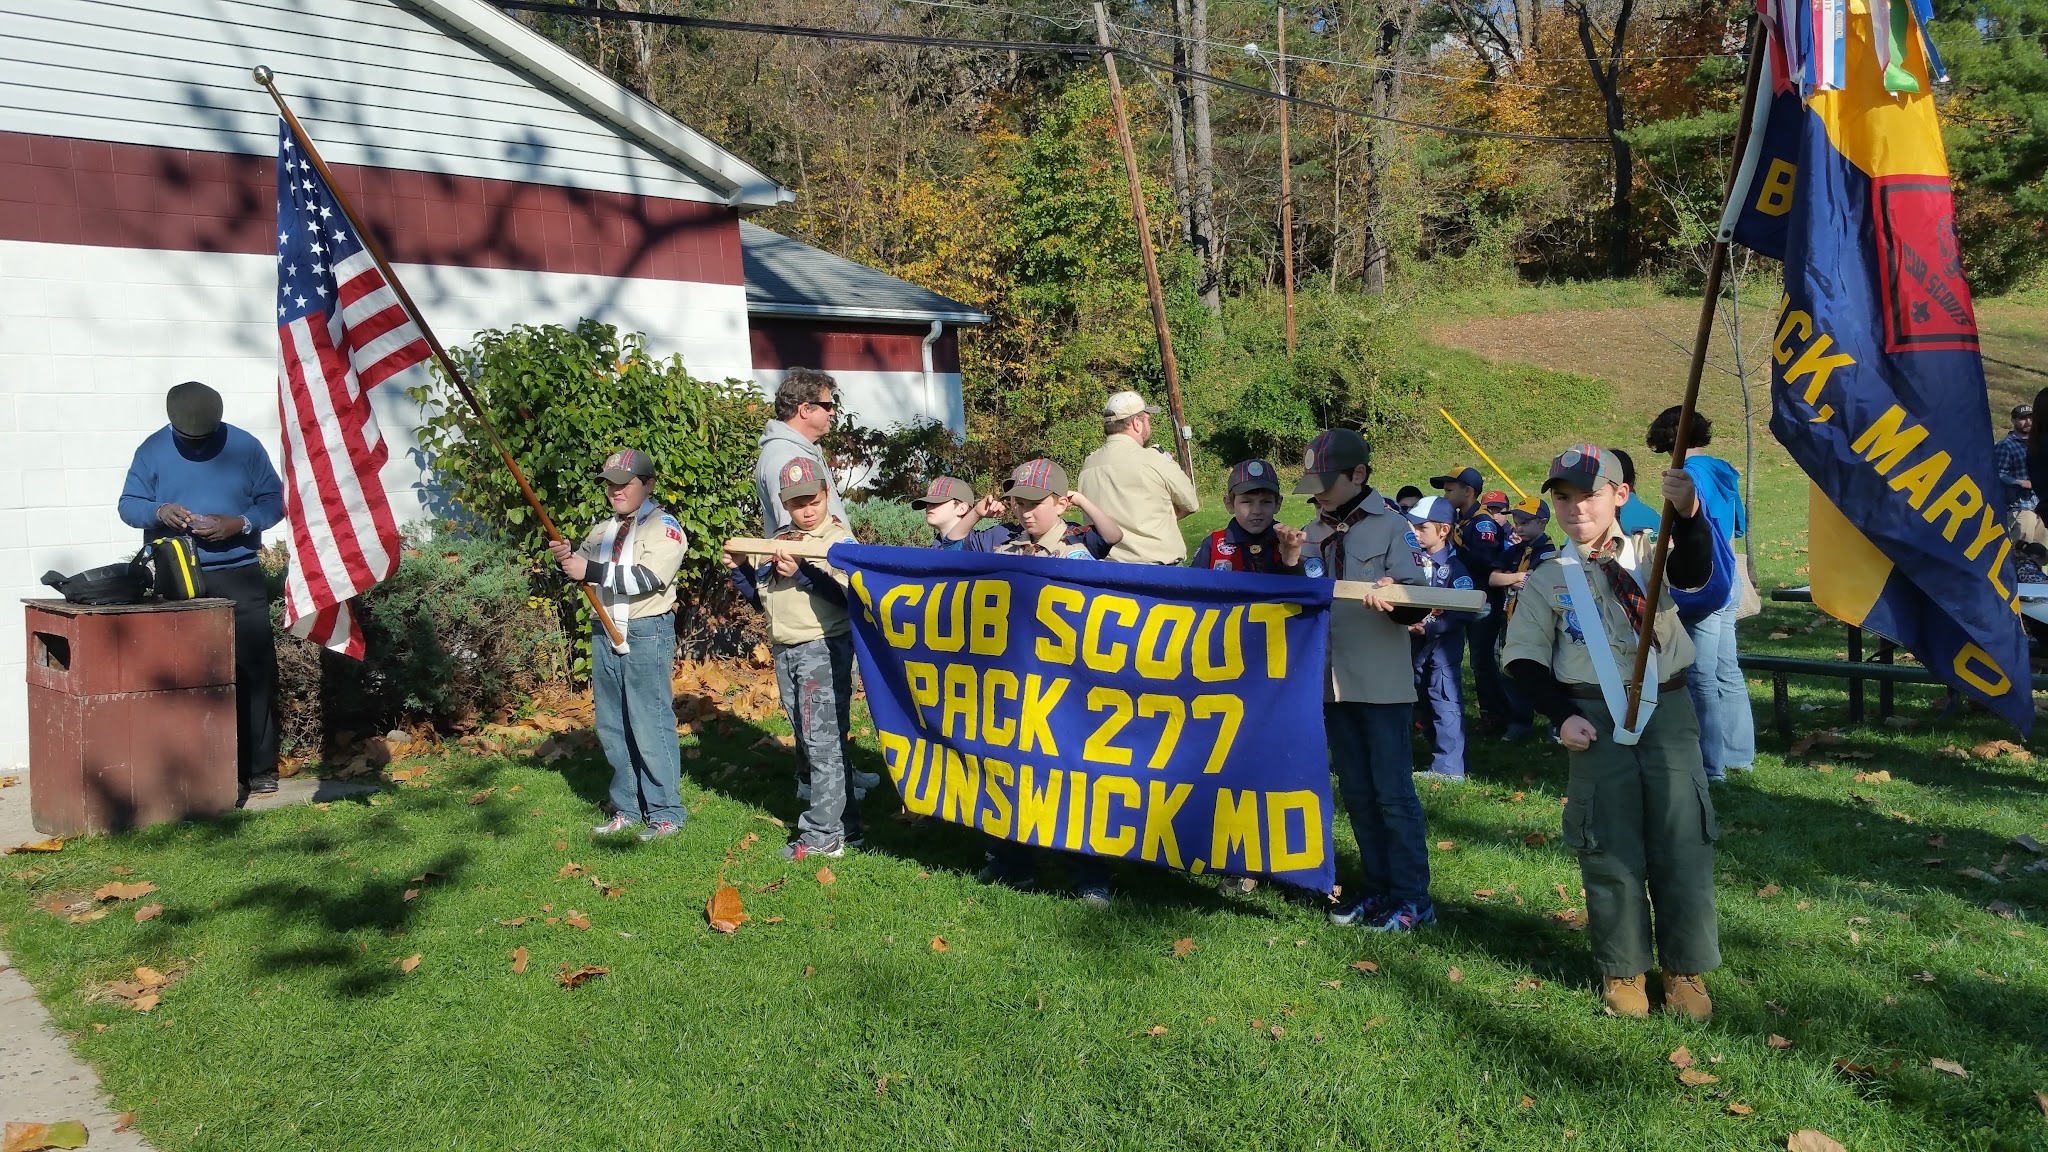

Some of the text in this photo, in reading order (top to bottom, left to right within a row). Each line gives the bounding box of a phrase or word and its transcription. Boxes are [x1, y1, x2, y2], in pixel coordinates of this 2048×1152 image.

[1902, 241, 1974, 327] CUB SCOUTS
[1481, 532, 1495, 541] 277
[1851, 404, 2021, 615] MARYL
[879, 579, 1303, 683] CUB SCOUT
[904, 660, 1070, 757] PACK
[1083, 686, 1244, 774] 277
